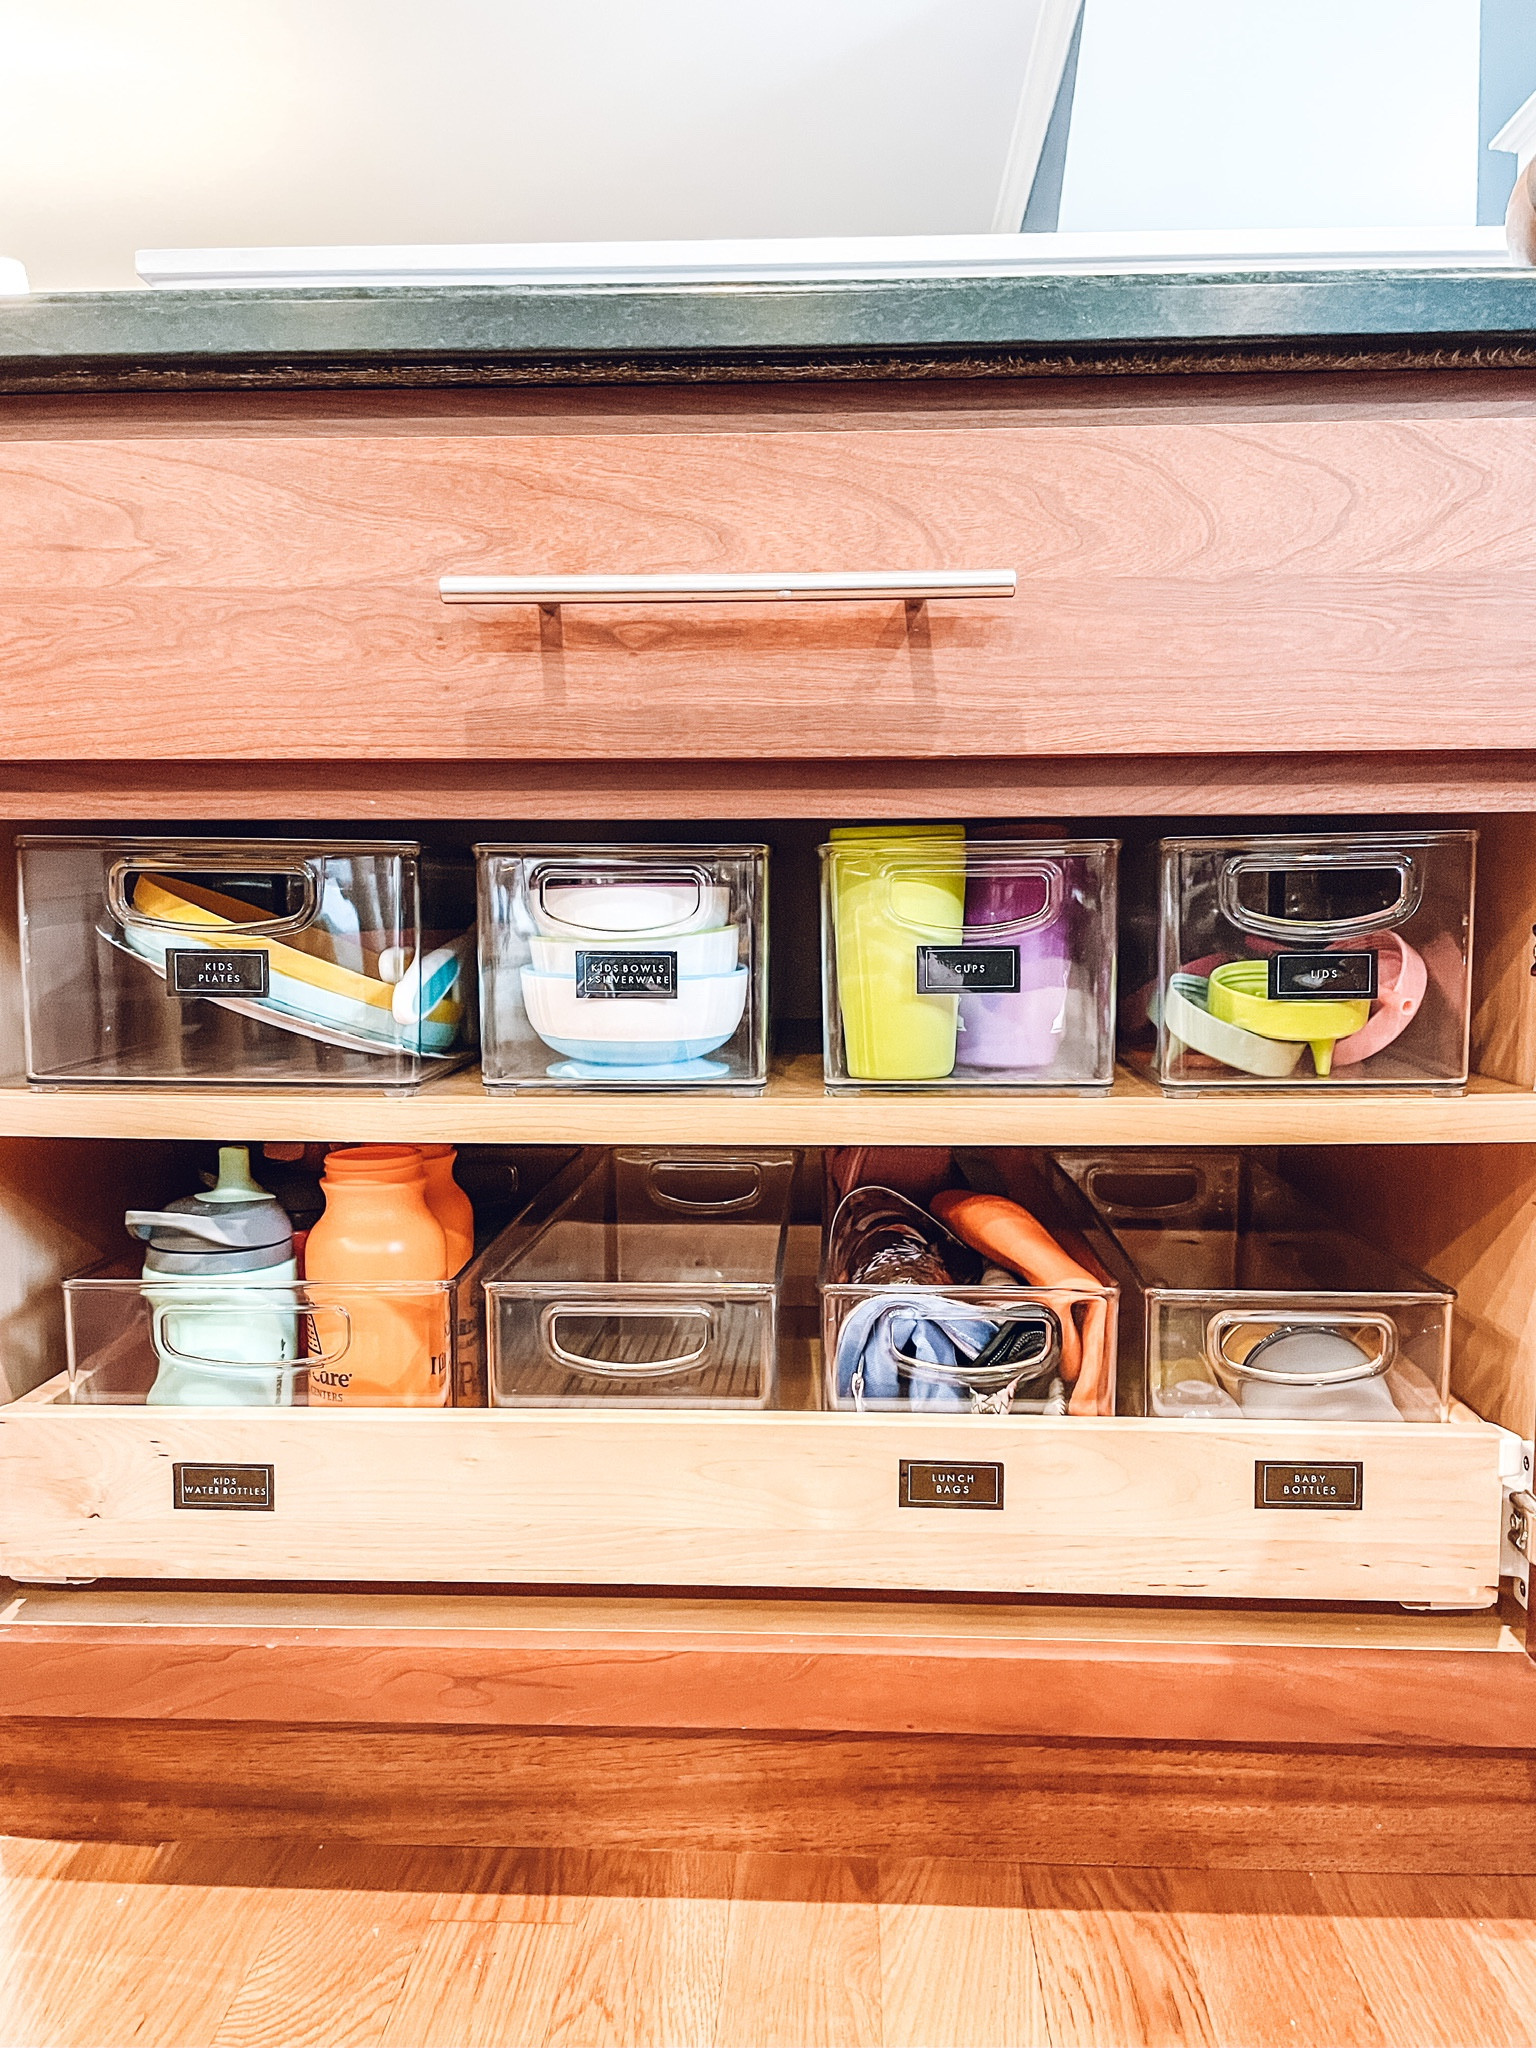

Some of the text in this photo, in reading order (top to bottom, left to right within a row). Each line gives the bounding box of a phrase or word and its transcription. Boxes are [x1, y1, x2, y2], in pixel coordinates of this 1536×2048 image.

[205, 962, 233, 971] KIDS
[591, 964, 664, 973] KIDS BOWLS
[954, 964, 986, 974] CUPS
[198, 974, 240, 983] PLATES
[1311, 969, 1338, 979] LIDS
[213, 1477, 237, 1485] KIDS
[931, 1473, 974, 1483] LUNCH
[1294, 1474, 1326, 1483] BABY
[222, 1487, 266, 1496] BOTTLES
[936, 1485, 970, 1494] BAGS
[1283, 1485, 1337, 1495] BOTTLES
